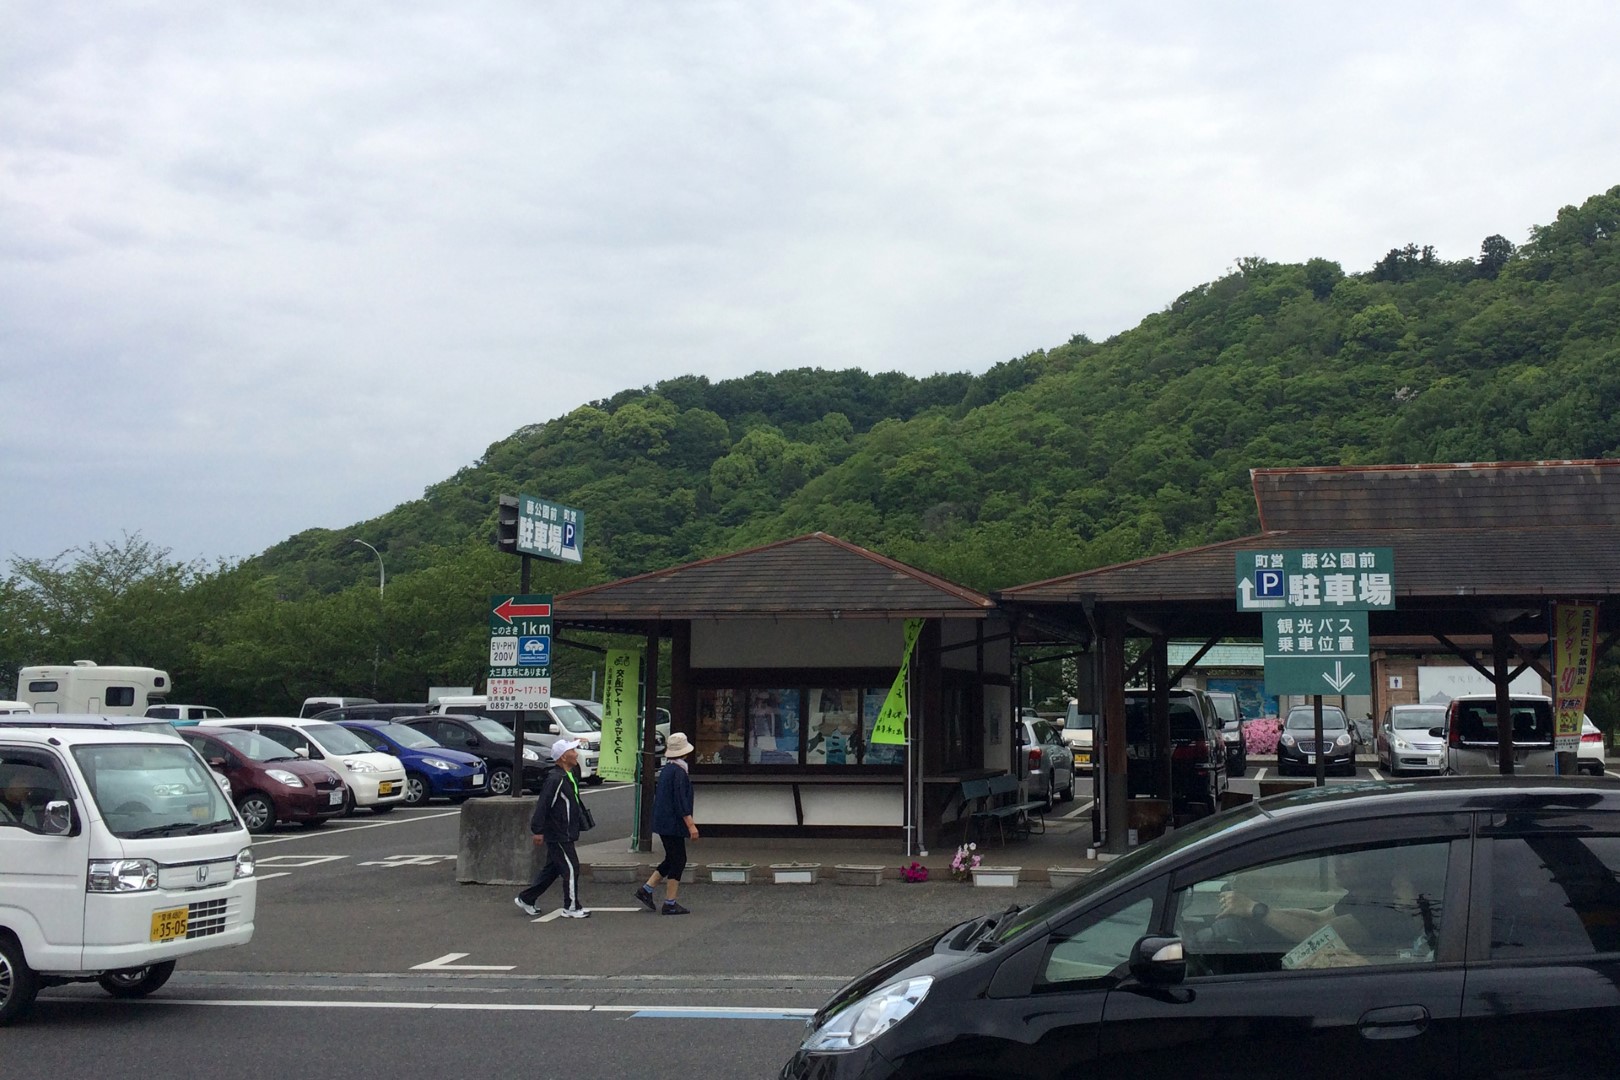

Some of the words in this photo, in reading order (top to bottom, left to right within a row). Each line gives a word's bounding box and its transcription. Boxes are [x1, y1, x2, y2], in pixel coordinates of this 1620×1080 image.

[519, 516, 562, 556] 駐車場
[566, 524, 574, 544] P
[1255, 553, 1284, 568] 町営
[1301, 552, 1376, 569] 藤公園前
[1262, 573, 1279, 595] P
[1288, 573, 1392, 606] 駐車場
[491, 626, 519, 635] このさき
[521, 621, 551, 635] 1km
[1277, 618, 1353, 634] 観光バス
[1277, 636, 1355, 652] 乗車位置
[493, 651, 514, 661] 200V
[490, 702, 549, 710] 0897-82-0500
[160, 919, 186, 938] 35-05
